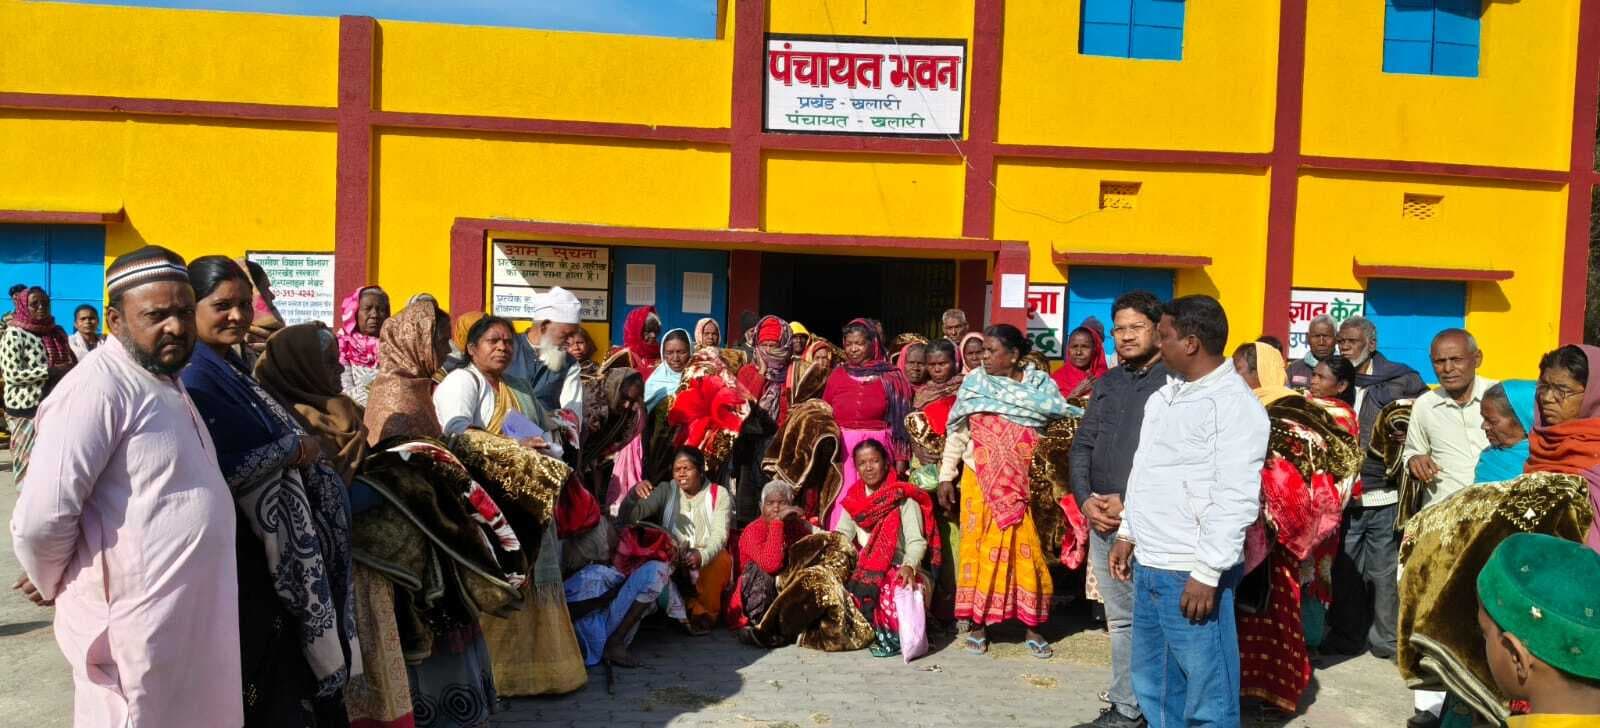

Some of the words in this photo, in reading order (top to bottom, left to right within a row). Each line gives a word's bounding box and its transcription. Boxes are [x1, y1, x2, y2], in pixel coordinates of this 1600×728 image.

[769, 42, 885, 89] पंचायत
[889, 54, 961, 91] भवन
[796, 94, 836, 110] प्रखंड
[850, 95, 902, 110] खलारी
[786, 110, 849, 128] पंचायत
[870, 113, 925, 129] खलारी
[504, 245, 538, 257] आम
